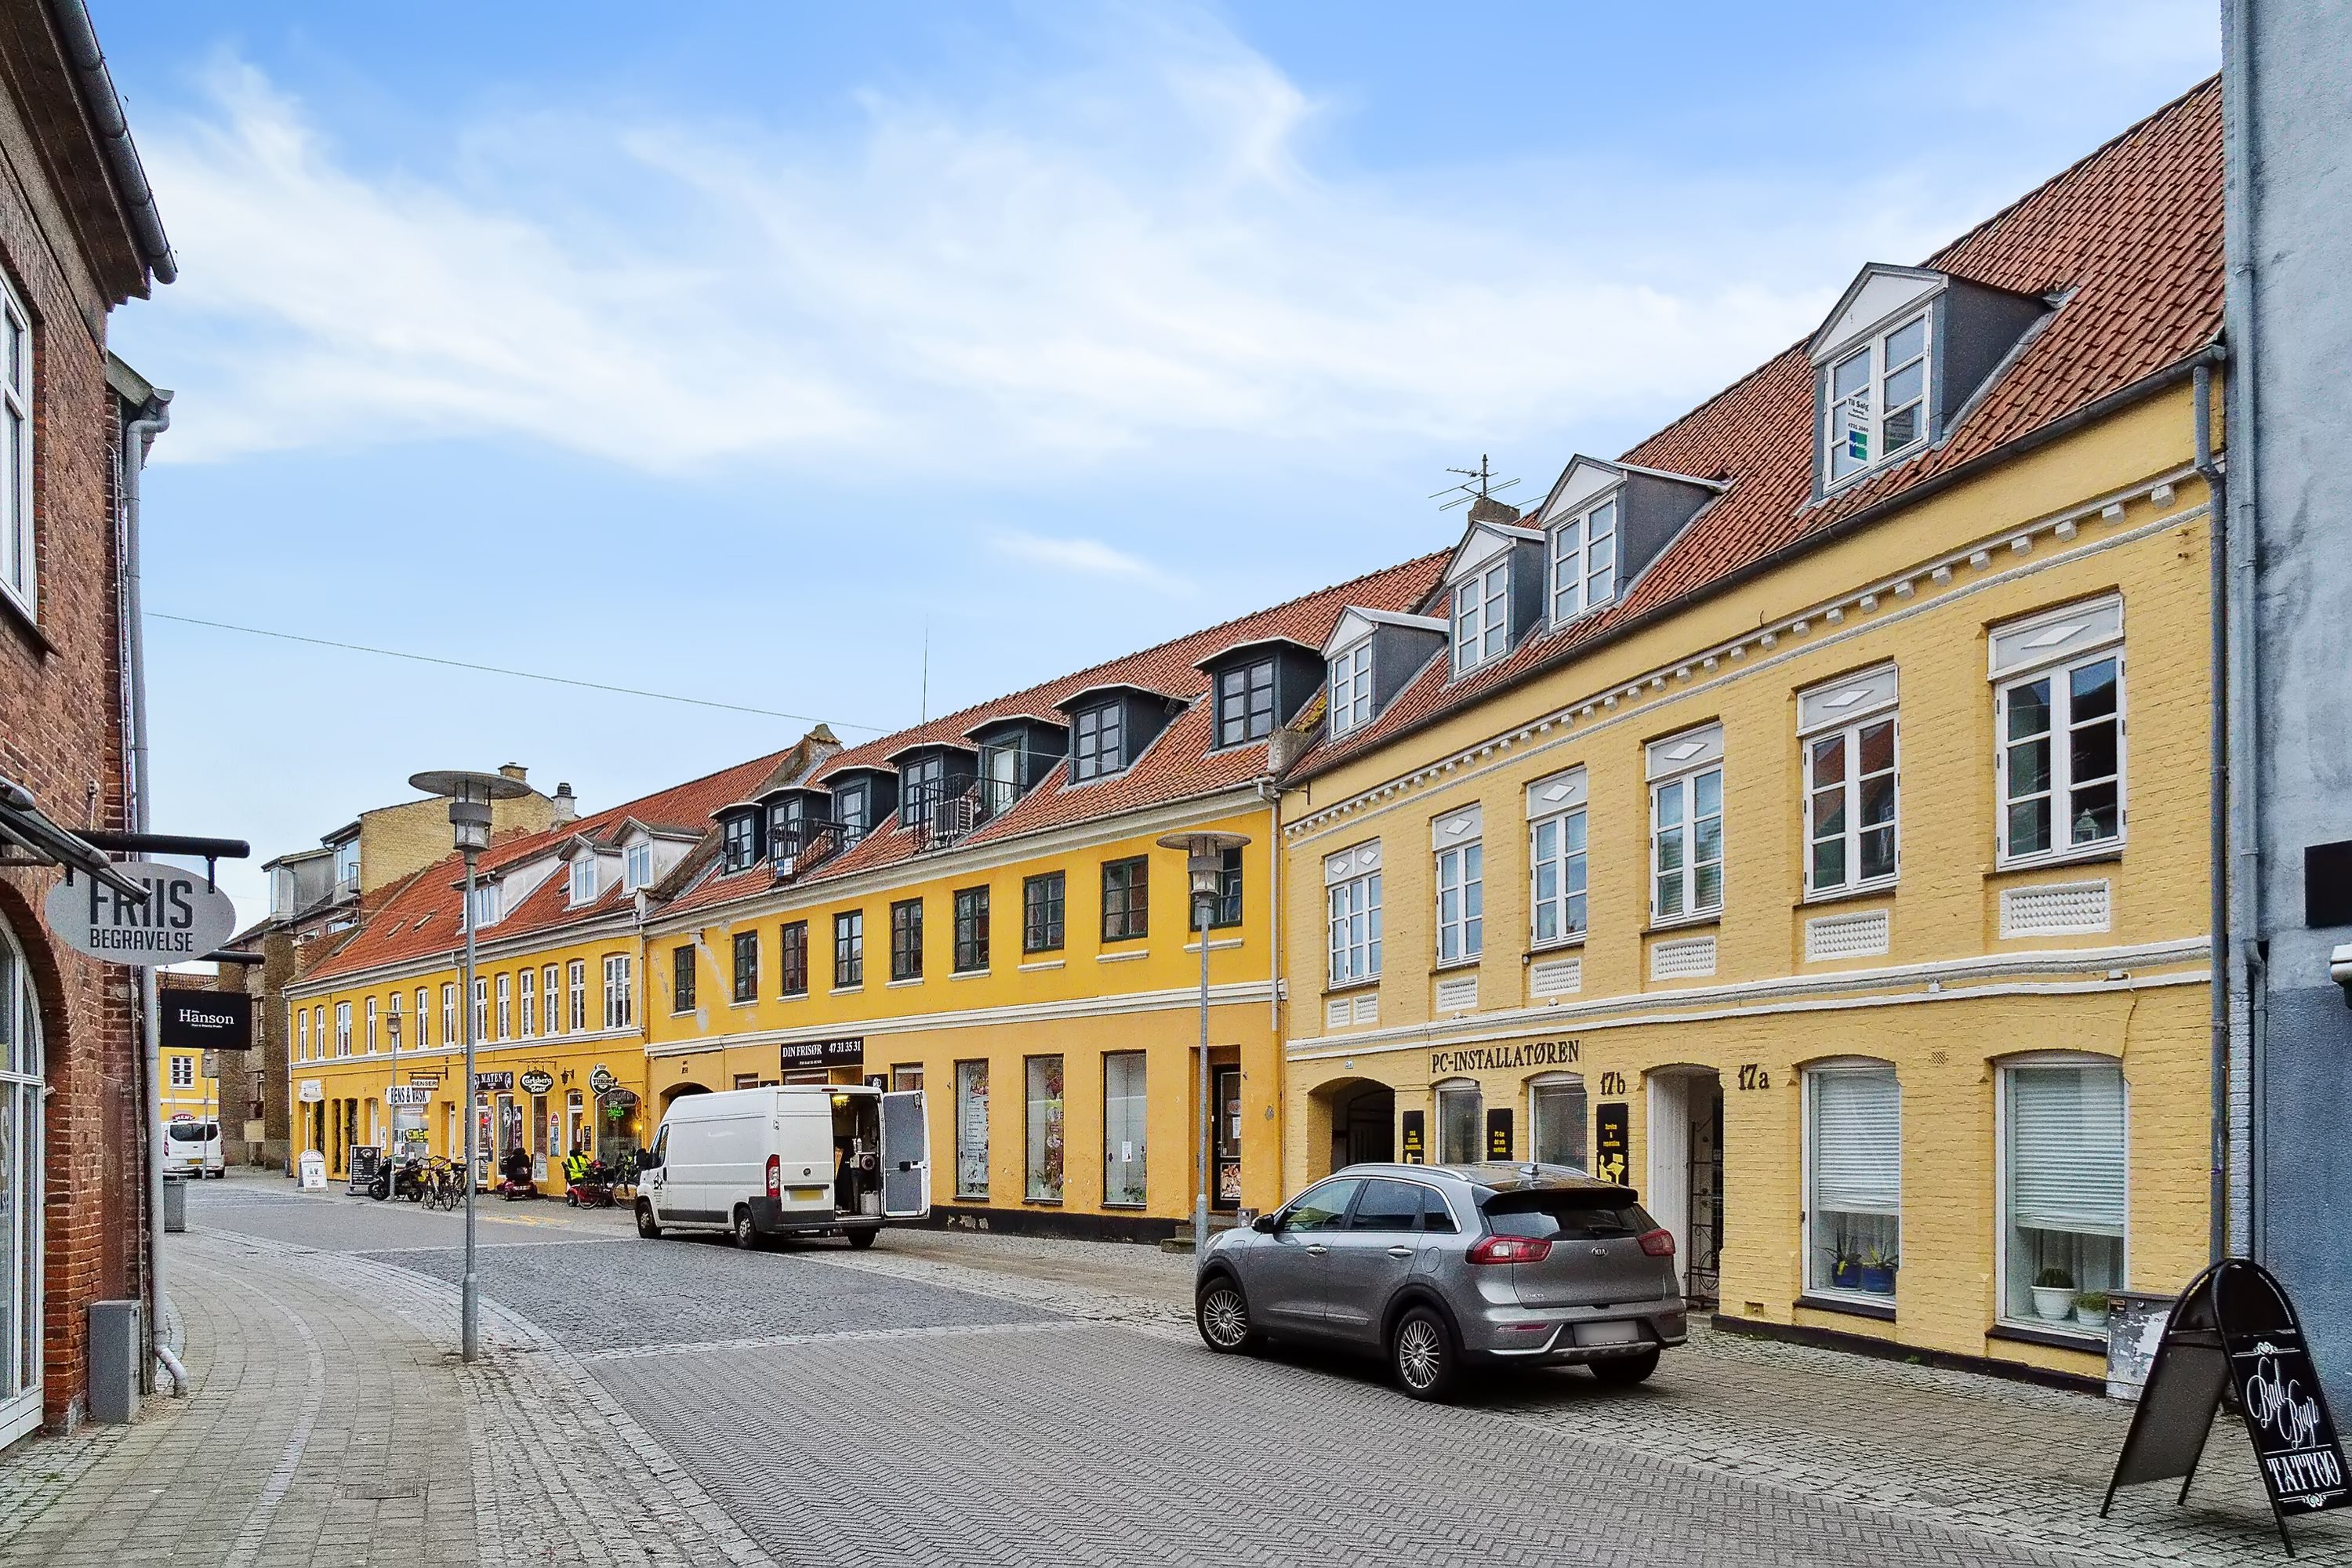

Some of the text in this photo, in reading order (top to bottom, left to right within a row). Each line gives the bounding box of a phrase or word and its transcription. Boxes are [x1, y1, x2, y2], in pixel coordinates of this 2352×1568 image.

[90, 875, 193, 929] FRIIS
[90, 928, 194, 953] BEGRAVELSE
[179, 1008, 234, 1025] Hanson
[782, 1040, 861, 1058] DIN FRISØR 47 31 35 31
[1432, 1040, 1580, 1073] PC-INSTALLATØREN
[521, 1074, 552, 1087] Carlsberg
[1600, 1071, 1626, 1095] 17b
[1737, 1063, 1770, 1091] 17a
[2246, 1356, 2285, 1428] Bad
[2266, 1450, 2341, 1494] TATTOO
